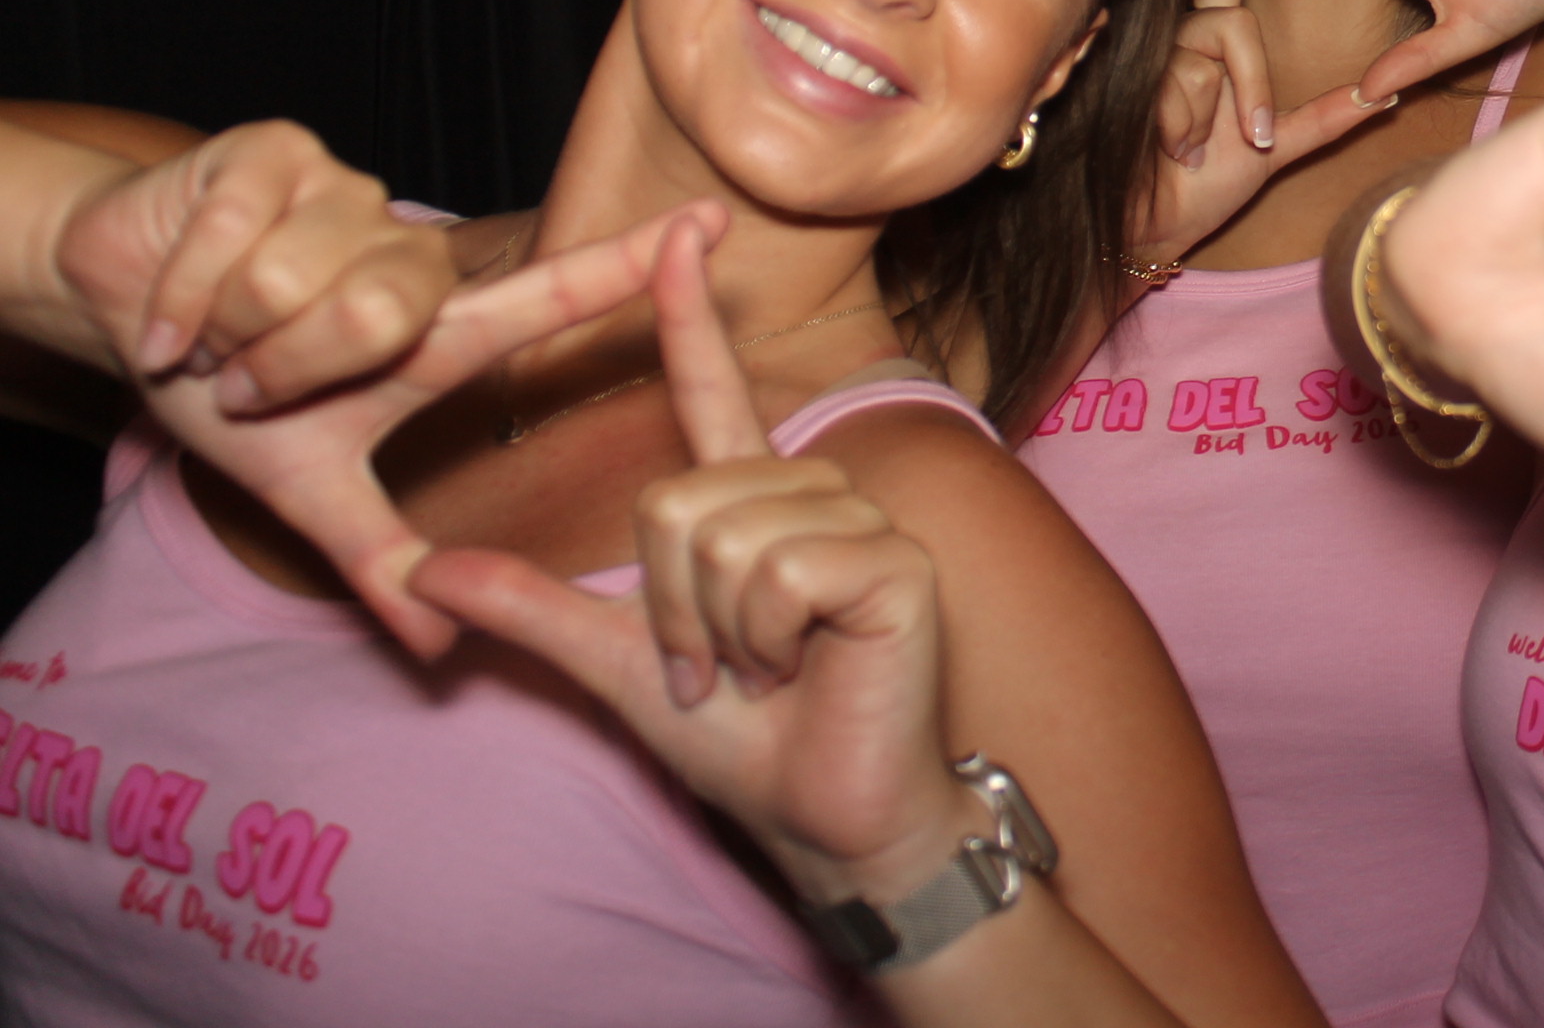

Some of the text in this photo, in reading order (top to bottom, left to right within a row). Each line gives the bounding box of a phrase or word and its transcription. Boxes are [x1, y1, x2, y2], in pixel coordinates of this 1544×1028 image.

[1034, 365, 1397, 437] LTA DEL SO
[1193, 433, 1246, 456] Bid
[1265, 426, 1339, 454] Day
[0, 708, 352, 929] LTA DEL SOL
[179, 884, 235, 962] Day
[244, 922, 321, 983] 2026
